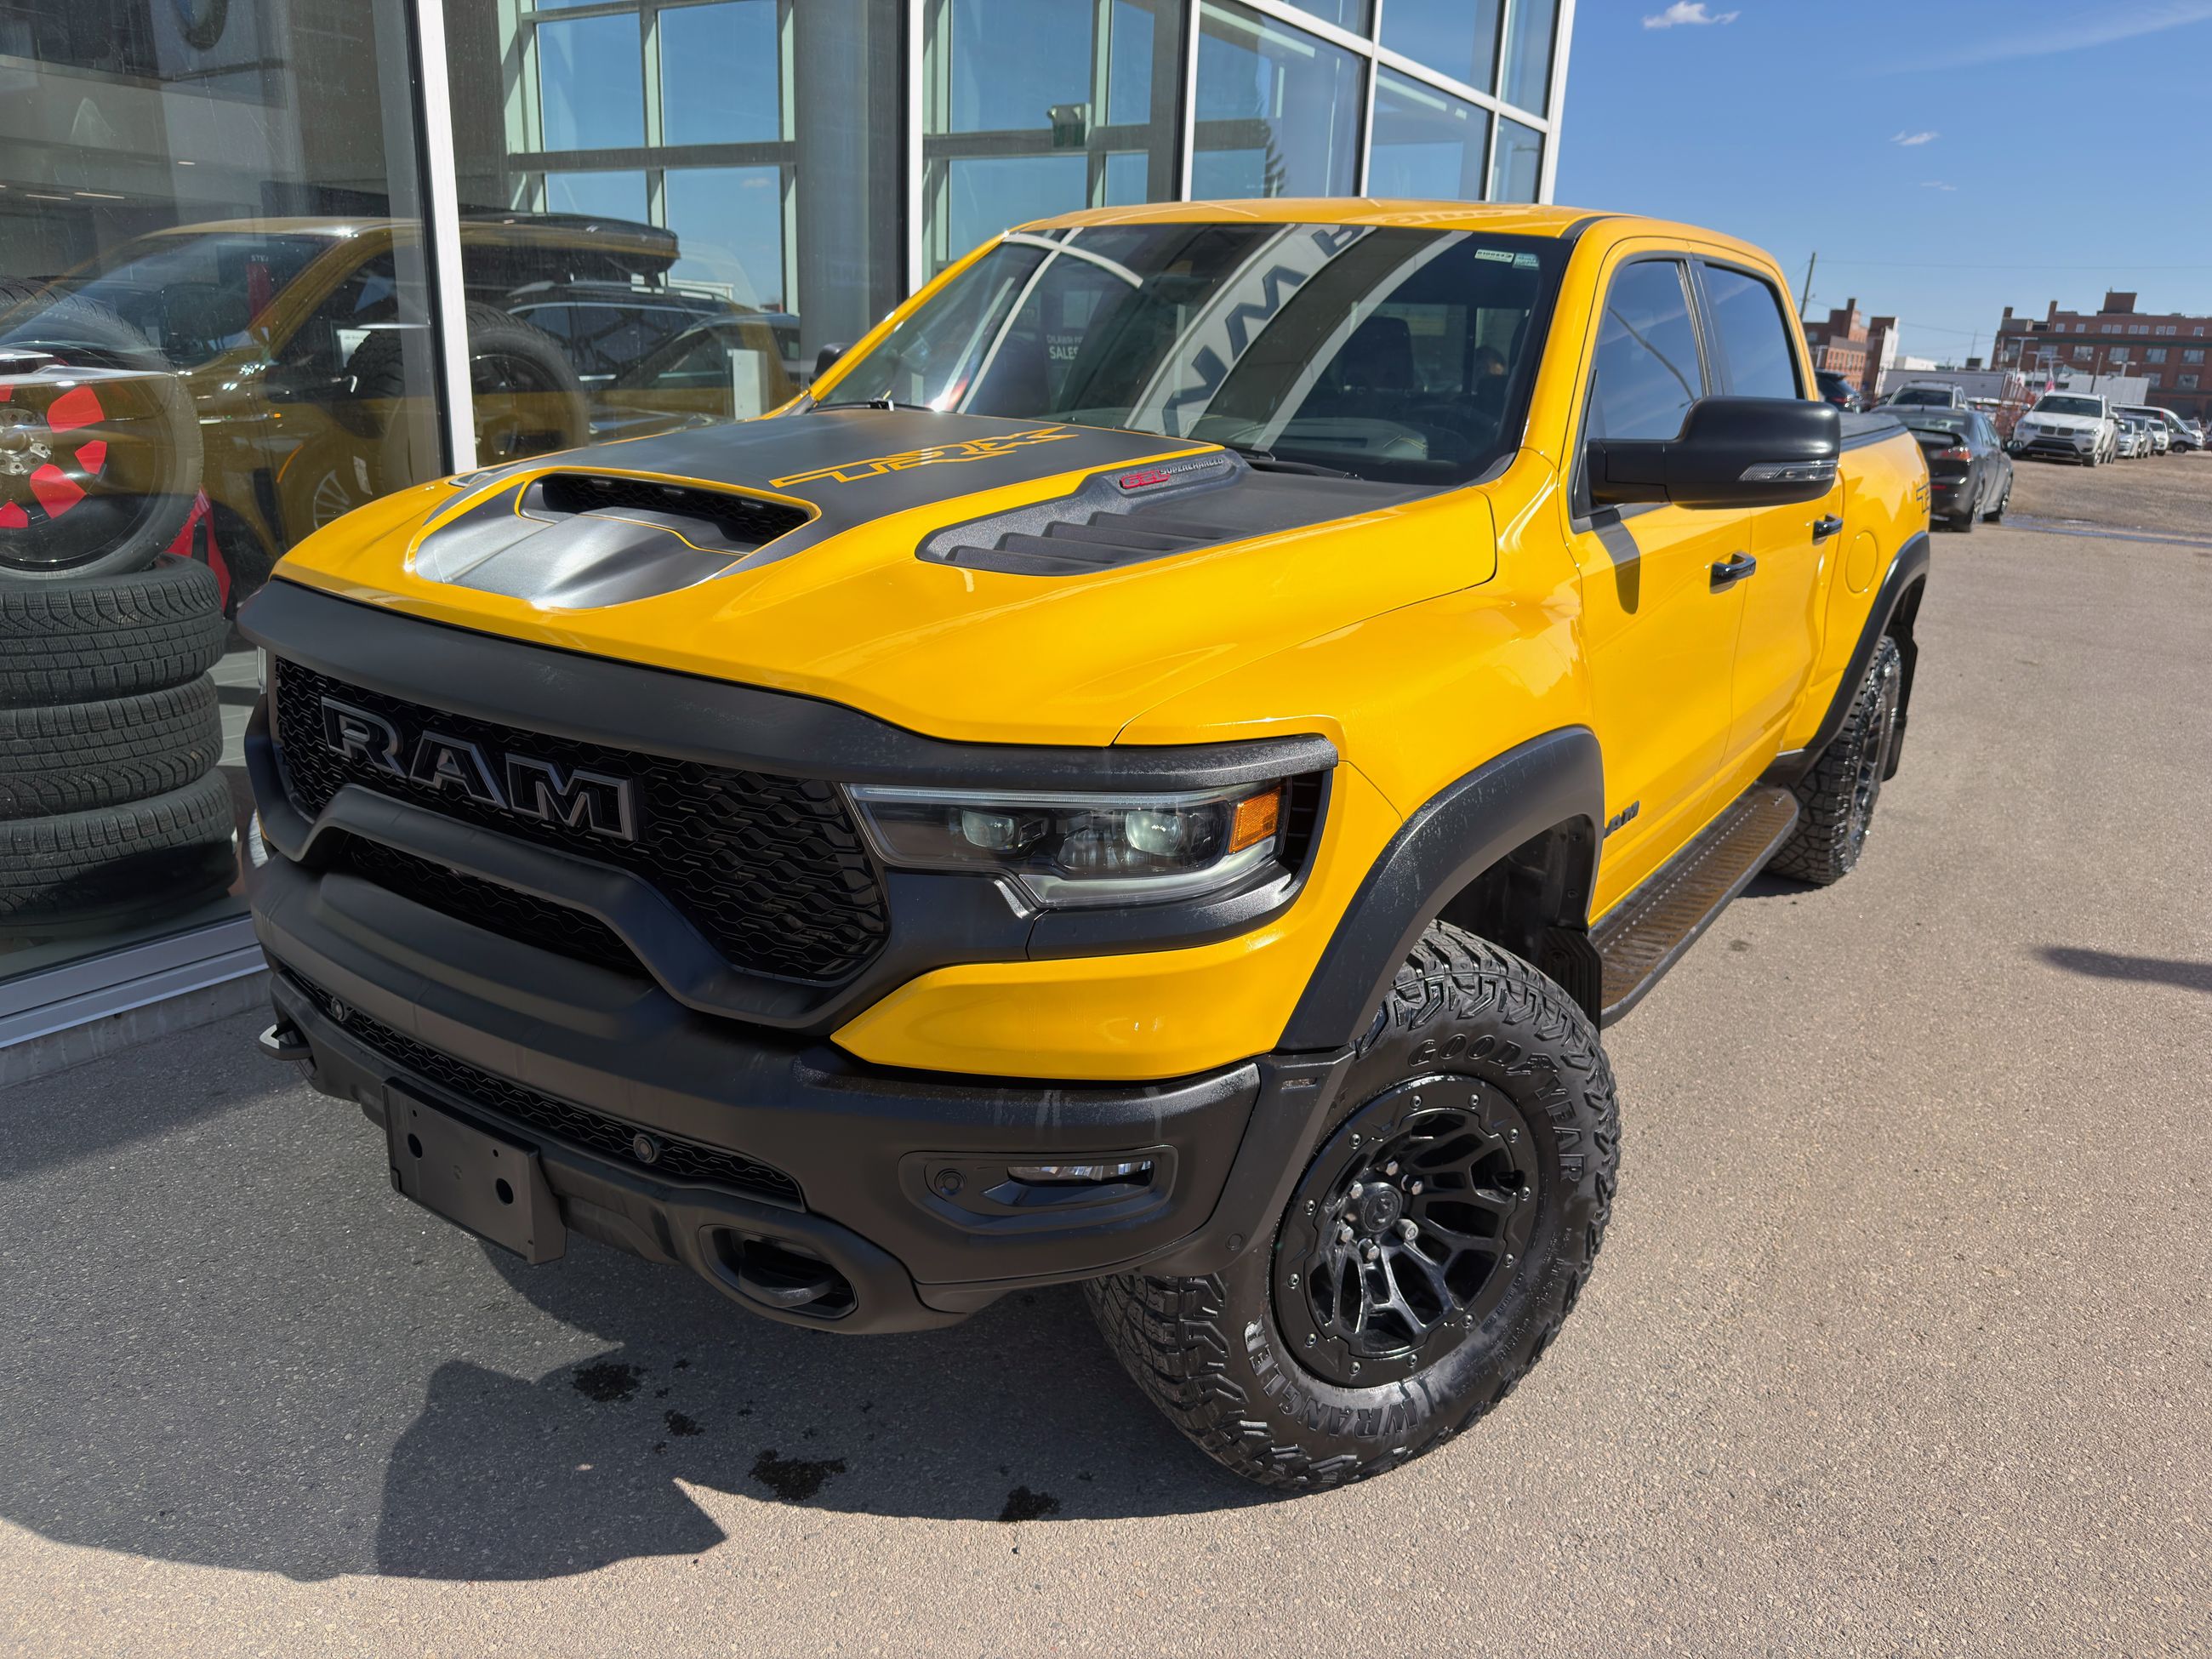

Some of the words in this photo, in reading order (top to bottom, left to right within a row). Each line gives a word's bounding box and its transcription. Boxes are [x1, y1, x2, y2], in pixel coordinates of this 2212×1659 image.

[769, 425, 1079, 488] TRX
[1160, 458, 1223, 476] SUPERCHARGED
[321, 696, 638, 841] RAM
[1408, 1033, 1587, 1183] GOODYEAR
[1243, 1314, 1420, 1439] WRANGLER
